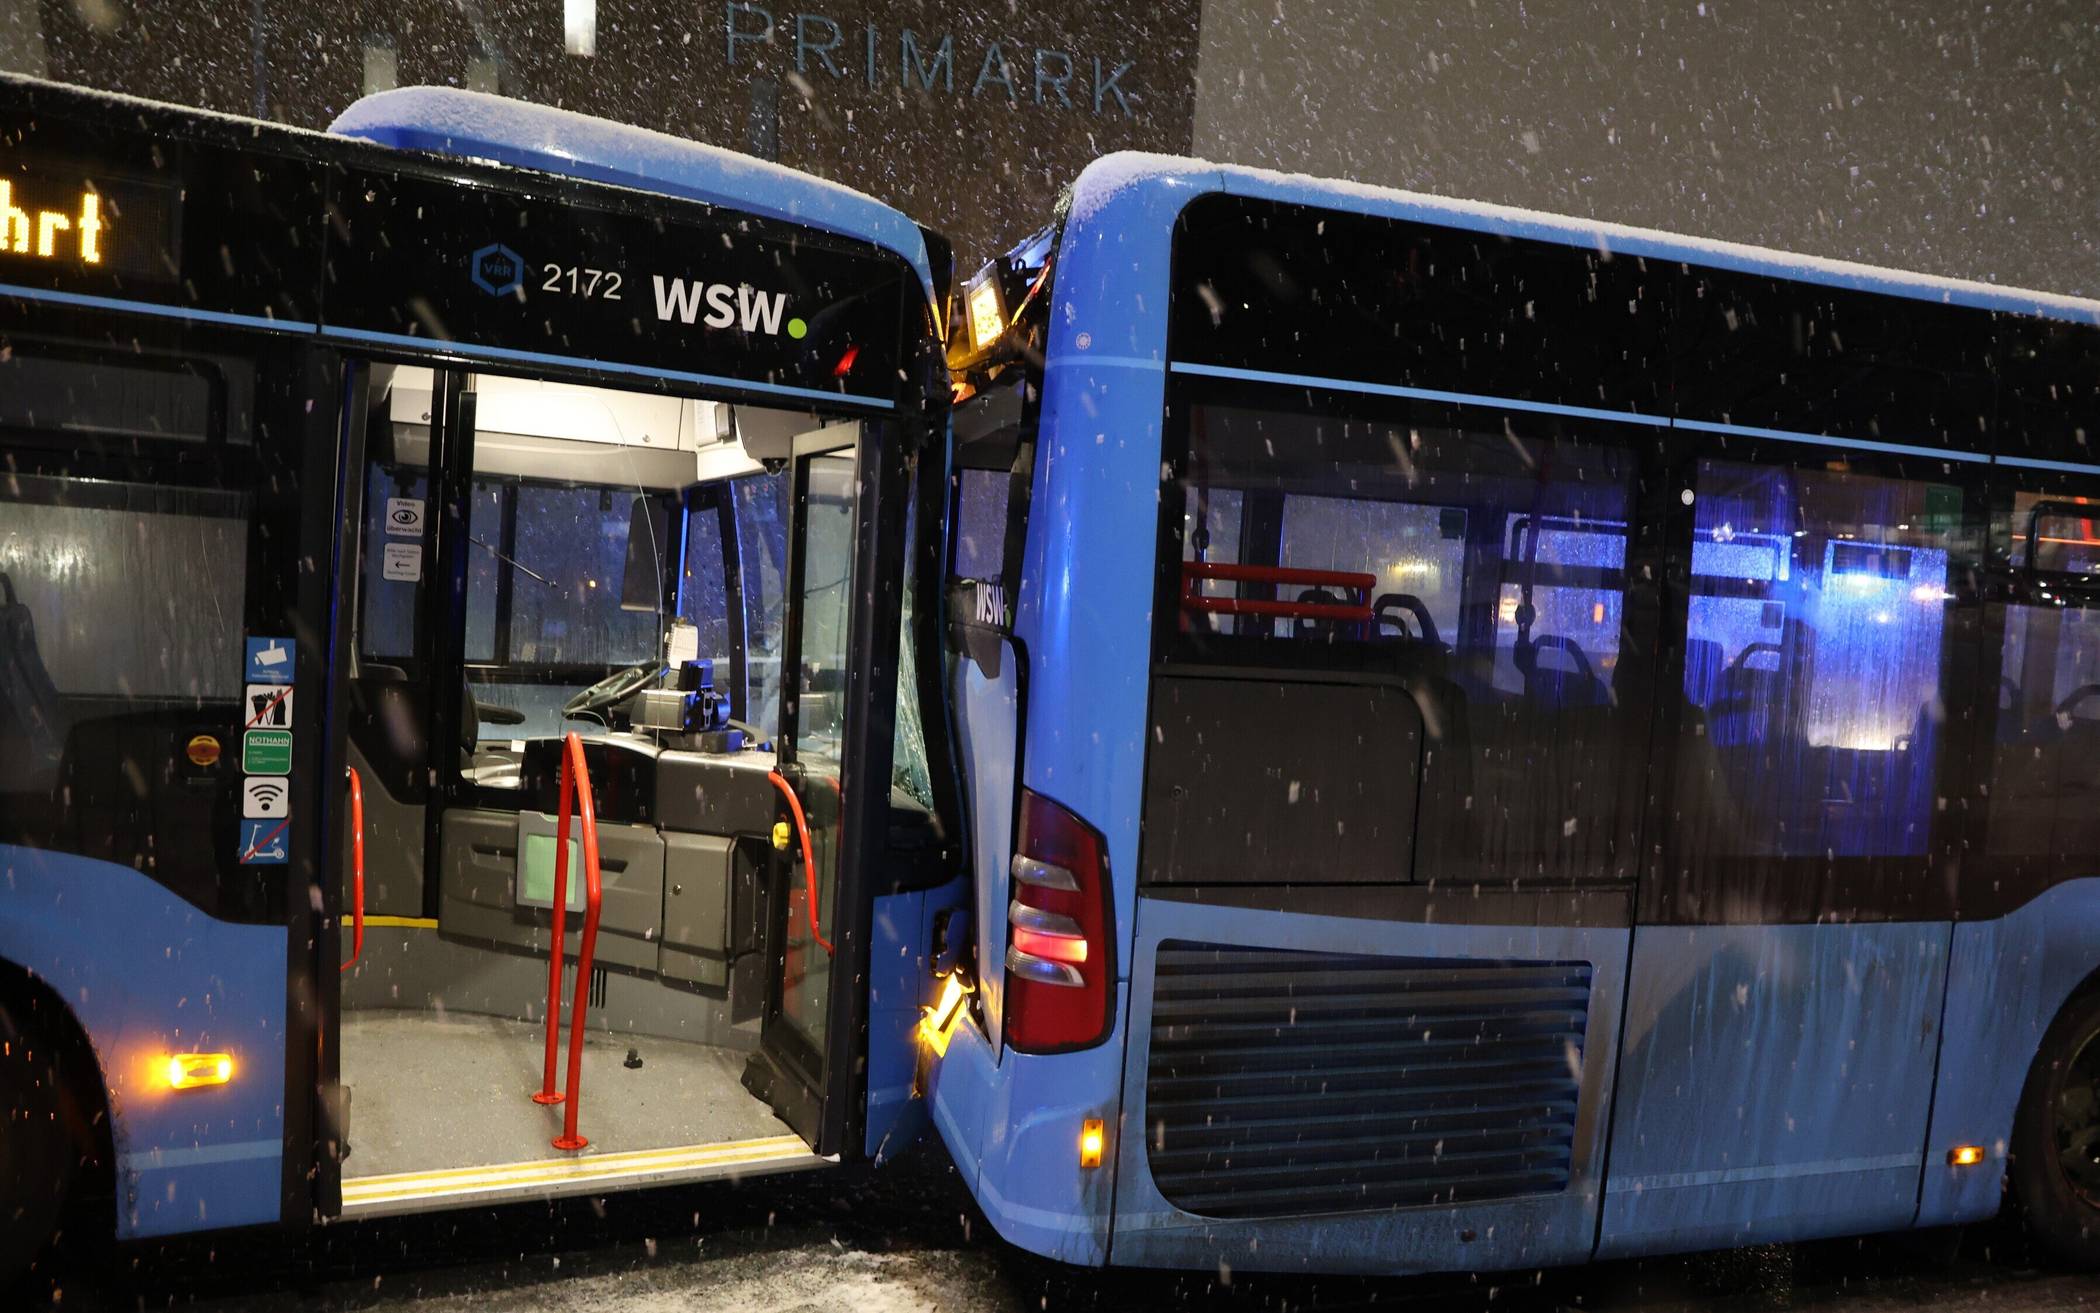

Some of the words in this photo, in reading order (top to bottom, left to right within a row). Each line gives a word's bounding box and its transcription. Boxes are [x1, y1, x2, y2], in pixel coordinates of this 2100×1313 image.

[727, 3, 1136, 119] PRIMARK
[542, 263, 622, 300] 2172
[652, 275, 786, 335] WSW
[976, 582, 1004, 626] WSW
[248, 736, 289, 746] NOTHAHN
